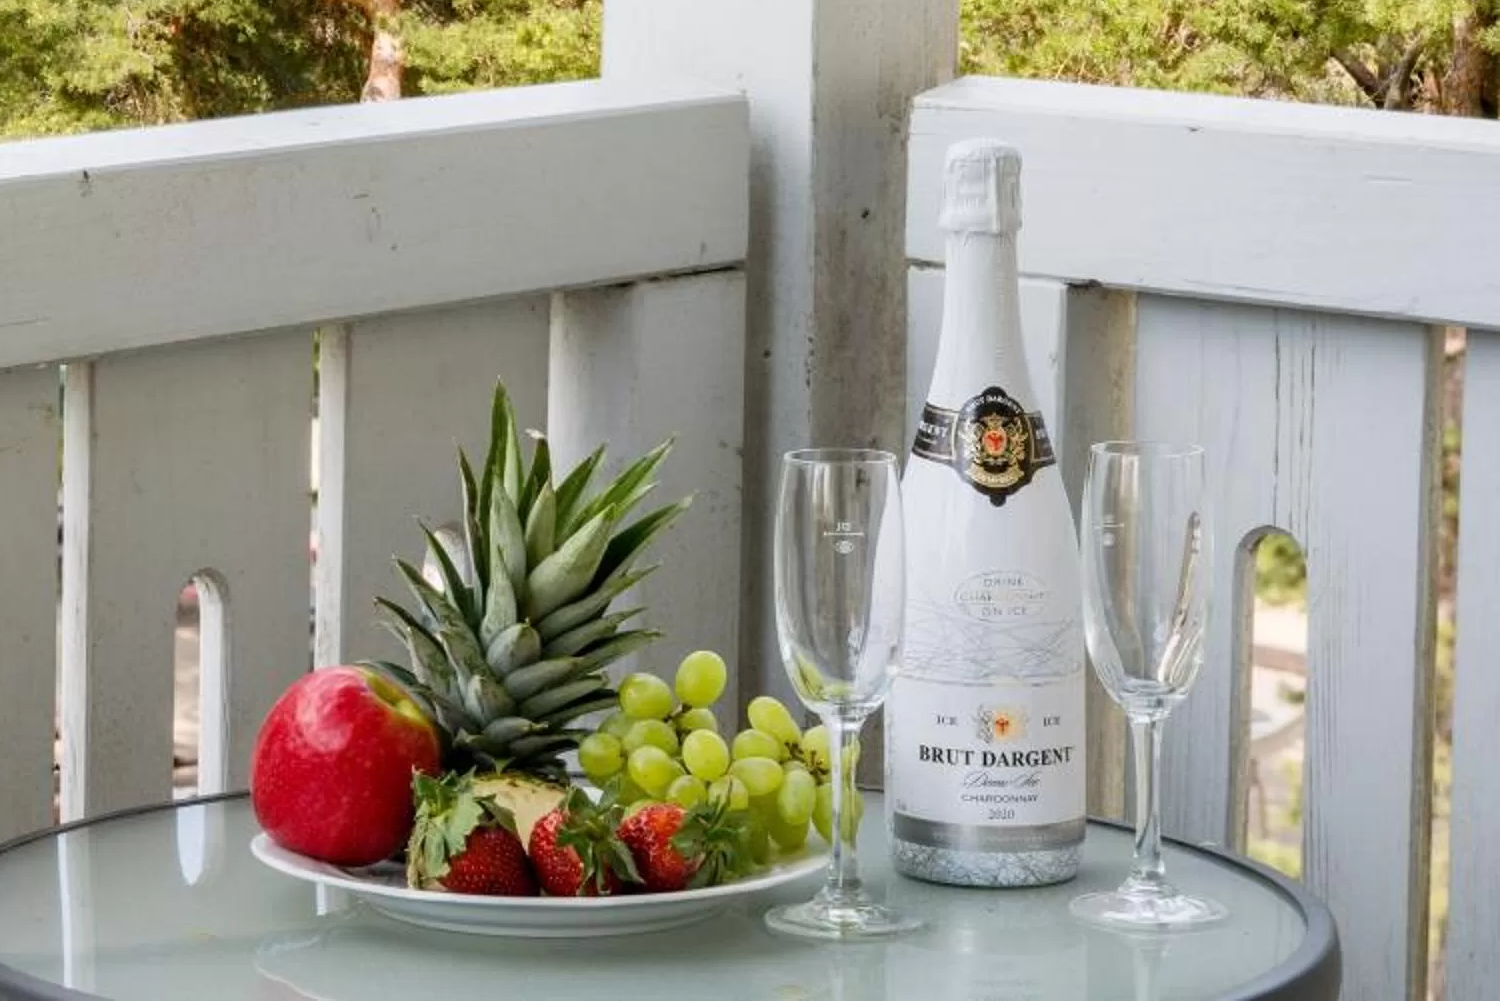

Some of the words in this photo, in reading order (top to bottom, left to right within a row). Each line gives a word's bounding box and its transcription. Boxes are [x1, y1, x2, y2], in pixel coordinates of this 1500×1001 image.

[936, 714, 958, 726] ICE
[1043, 716, 1061, 727] ICE
[919, 744, 975, 766] BRUT
[981, 746, 1073, 768] DARGENT
[961, 794, 1039, 804] CHARDONNAY
